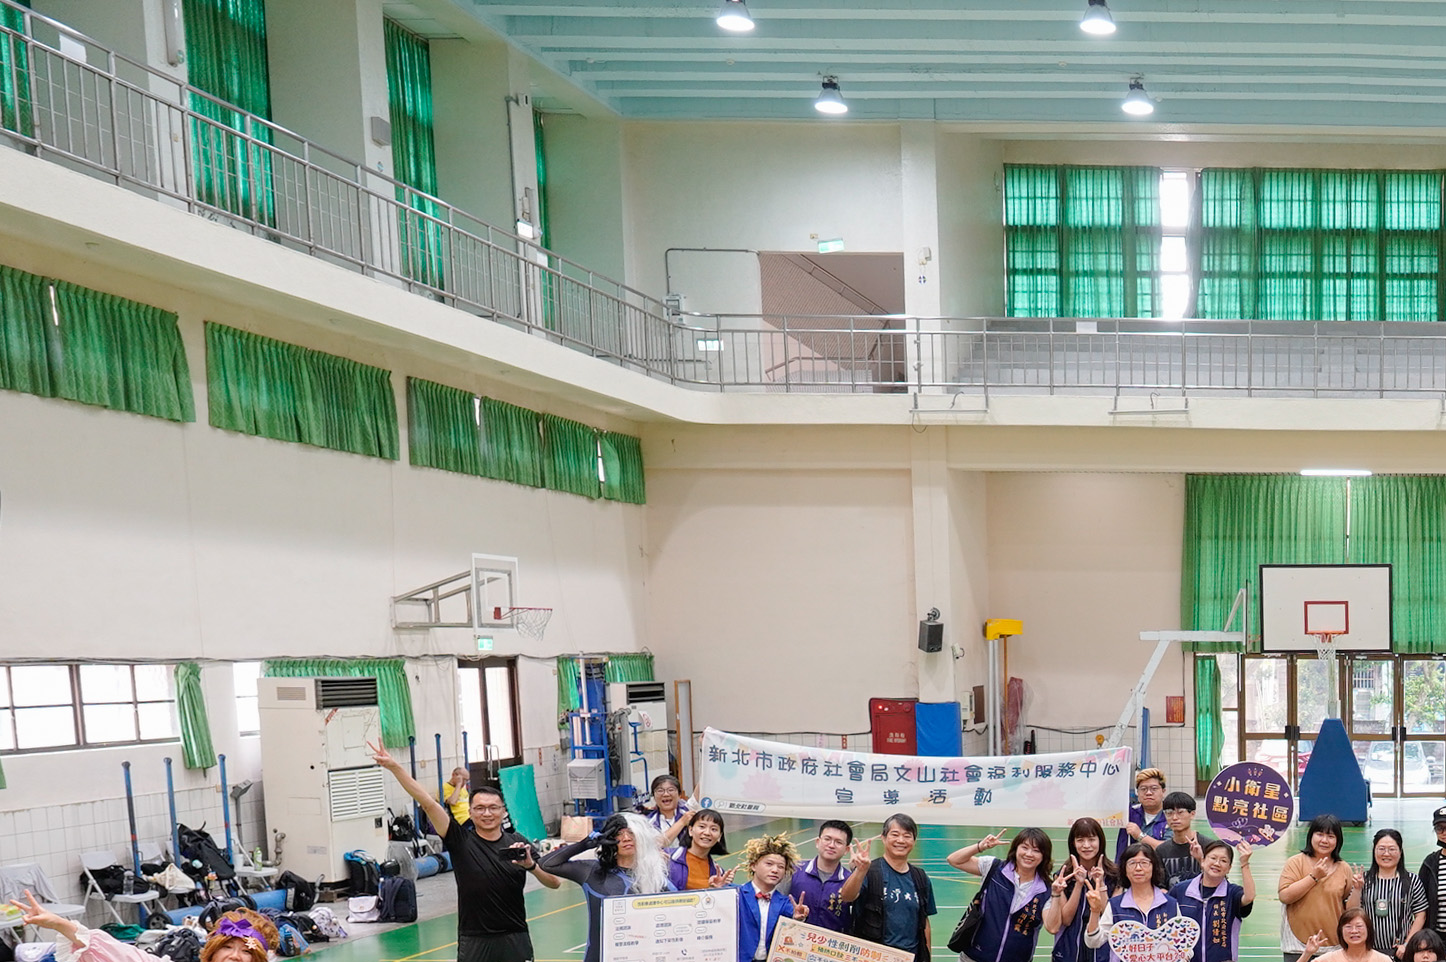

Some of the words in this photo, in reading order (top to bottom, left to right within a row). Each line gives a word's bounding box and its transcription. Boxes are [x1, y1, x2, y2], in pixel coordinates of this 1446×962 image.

[708, 744, 1120, 783] 新北市政府社會局文山社會福利服務中心
[835, 787, 992, 806] 宣導活動
[1224, 776, 1281, 800] 小衛星
[1212, 795, 1289, 823] 點亮社區
[806, 932, 882, 962] 兒少性剝削防制
[1129, 943, 1154, 953] 好日子
